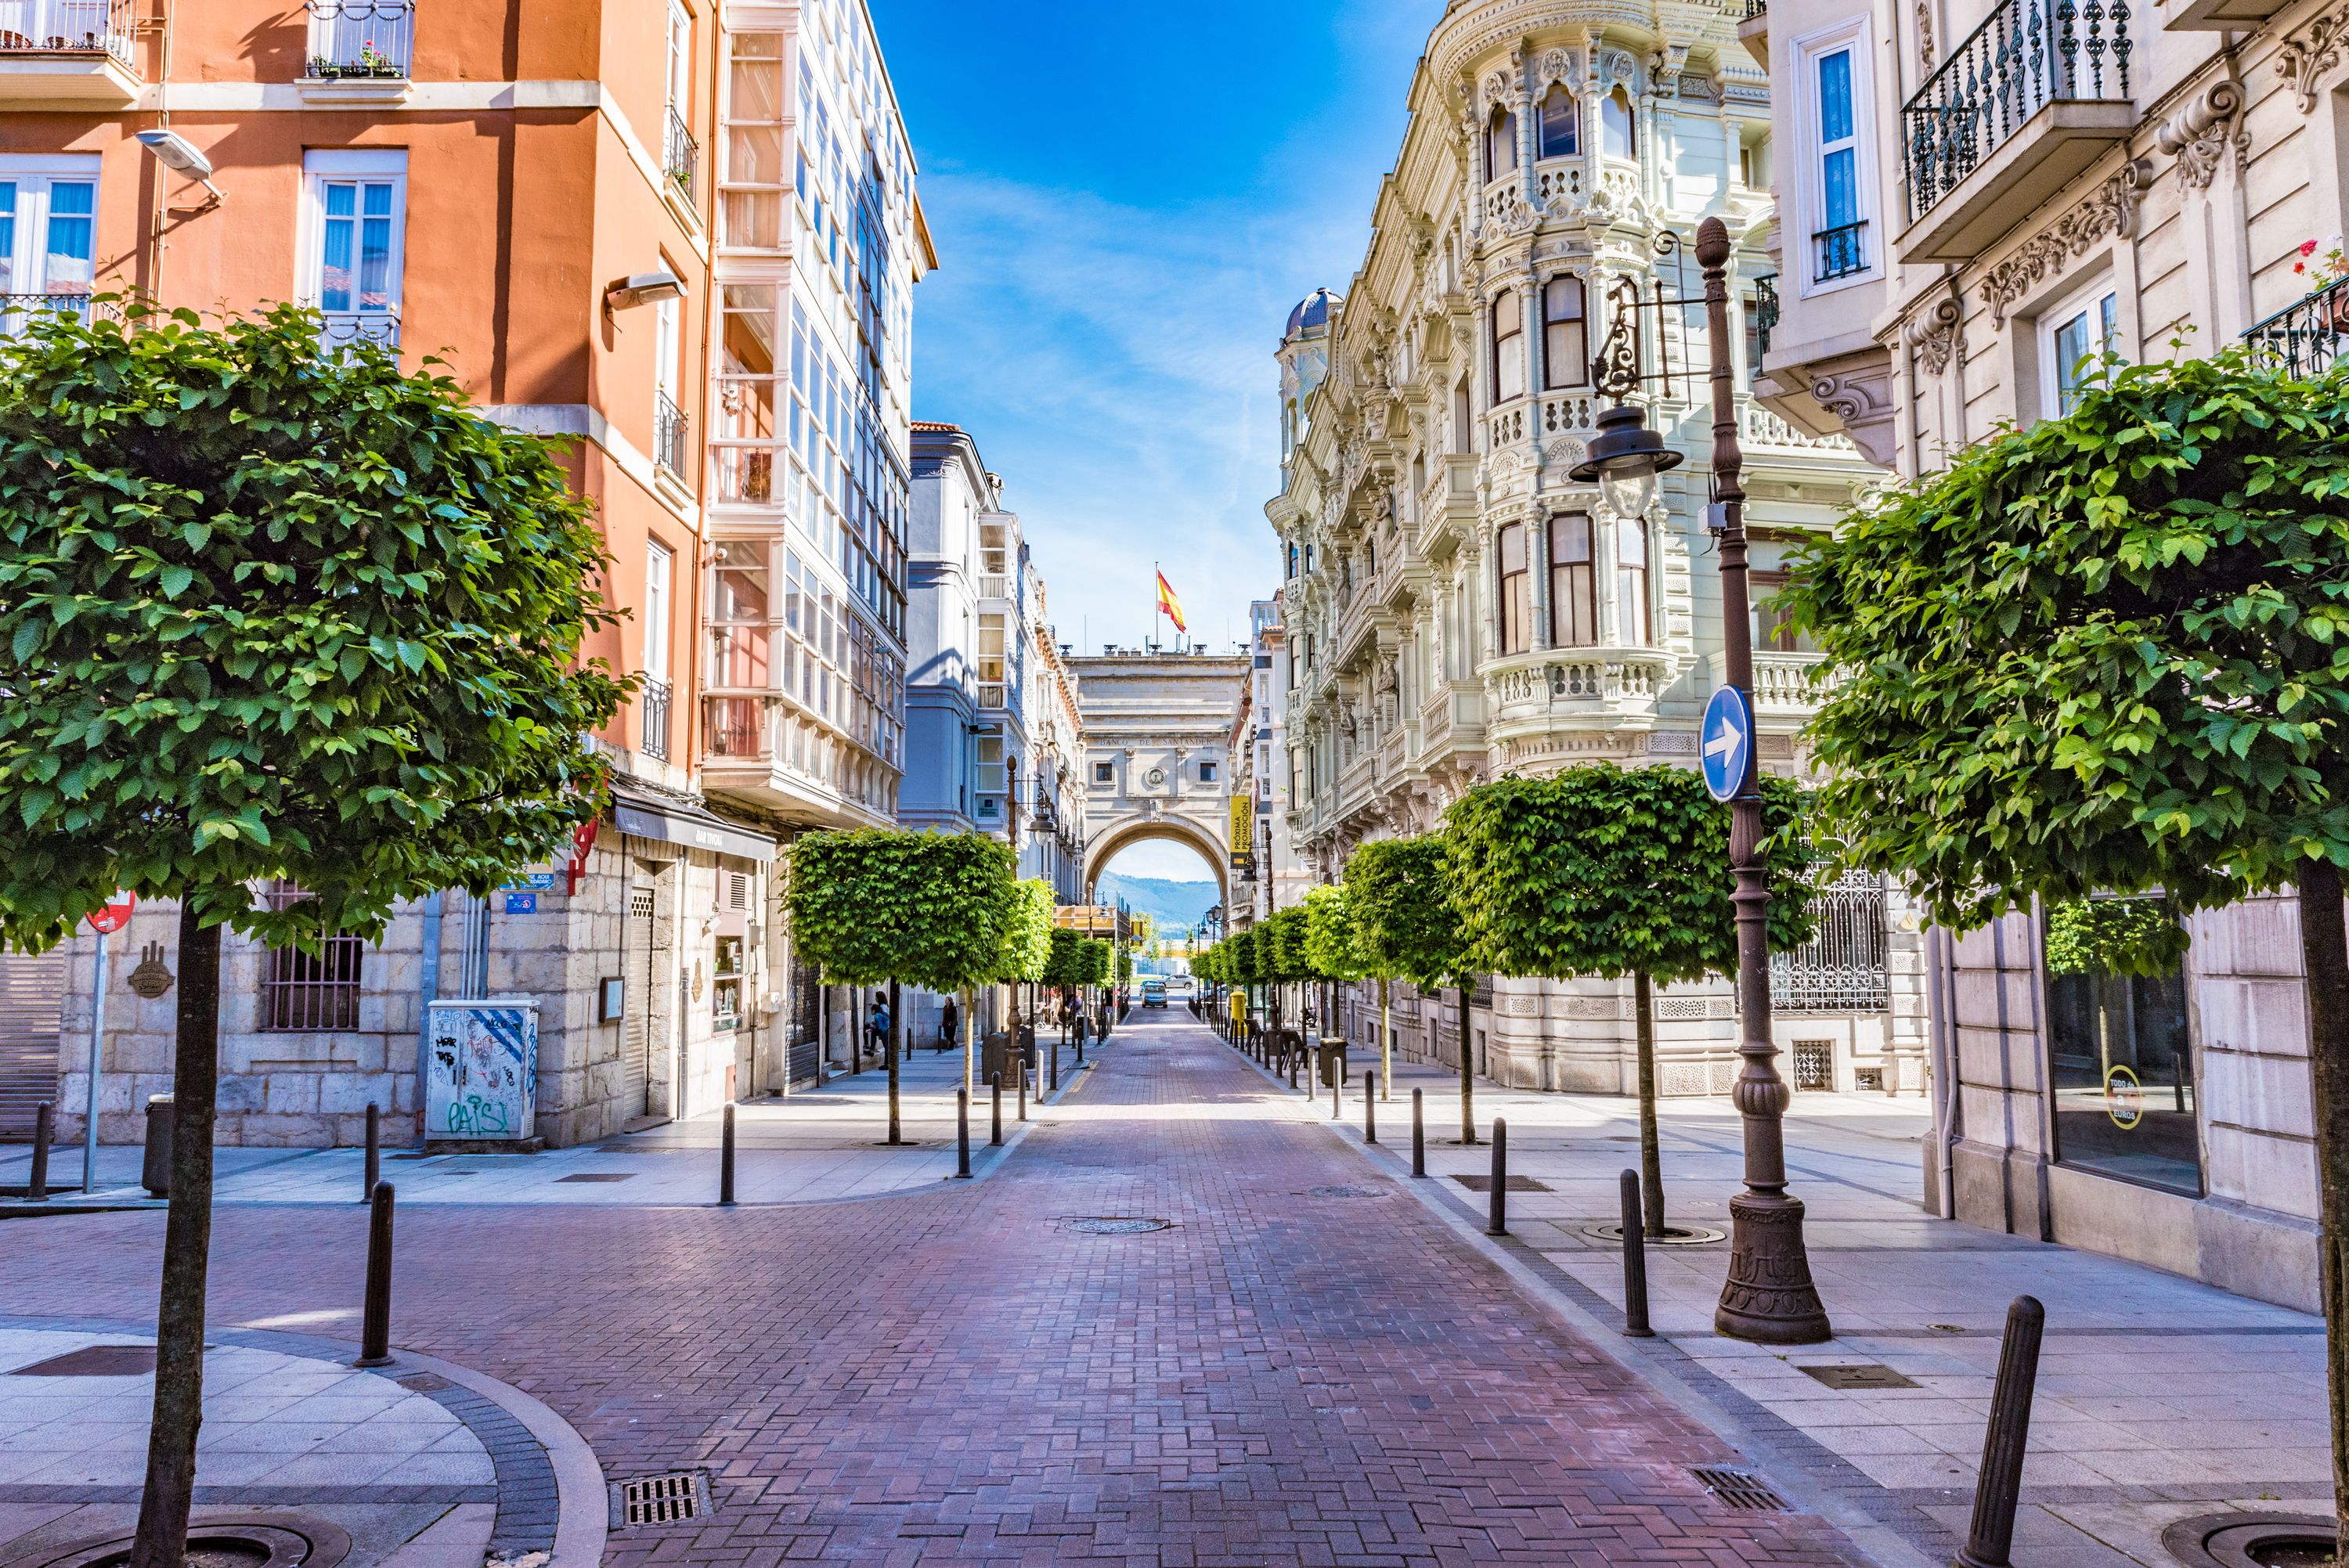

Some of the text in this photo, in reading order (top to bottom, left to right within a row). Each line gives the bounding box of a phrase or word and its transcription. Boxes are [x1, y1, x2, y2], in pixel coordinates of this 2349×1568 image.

[696, 829, 723, 846] BAR TIVOLI
[2110, 1079, 2126, 1087] TODO
[2113, 1110, 2135, 1120] EUROS
